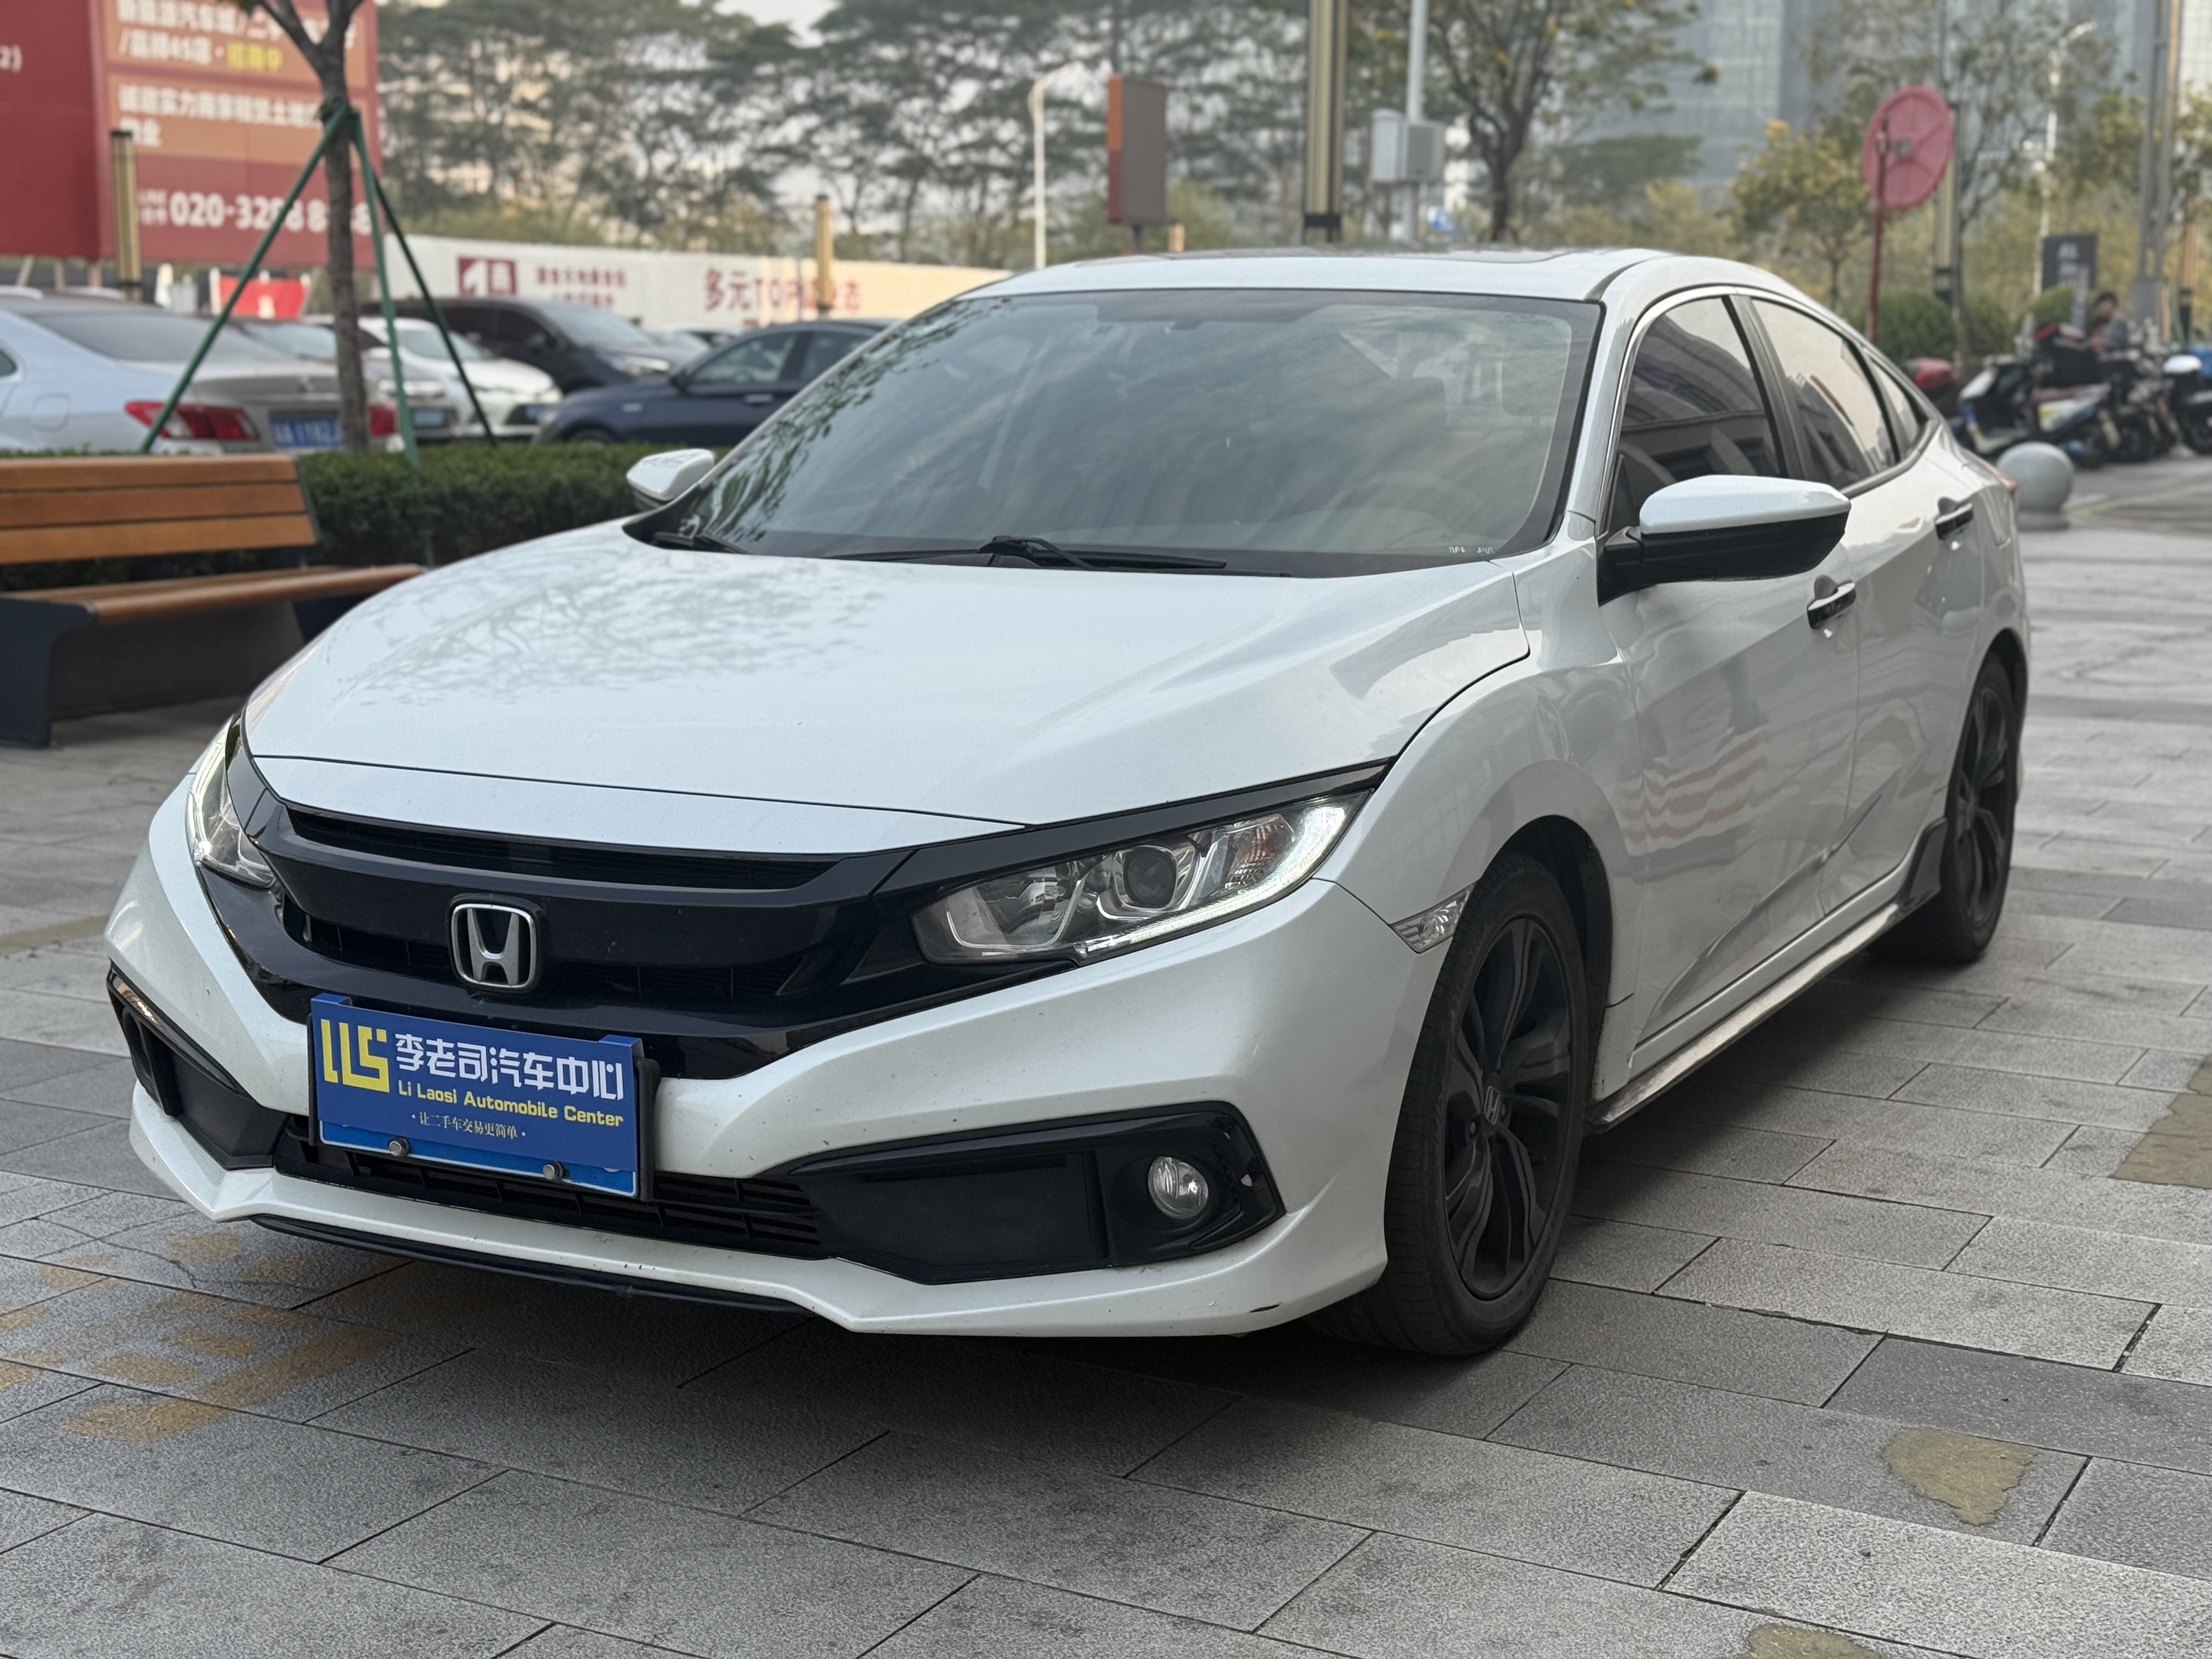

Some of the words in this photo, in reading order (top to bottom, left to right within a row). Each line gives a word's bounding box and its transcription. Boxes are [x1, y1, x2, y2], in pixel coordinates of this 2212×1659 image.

[396, 1034, 624, 1100] 李老司汽车中心
[398, 1080, 412, 1096] Li
[417, 1083, 457, 1104] Laosi
[464, 1091, 557, 1118] Automobile
[564, 1105, 624, 1127] Center
